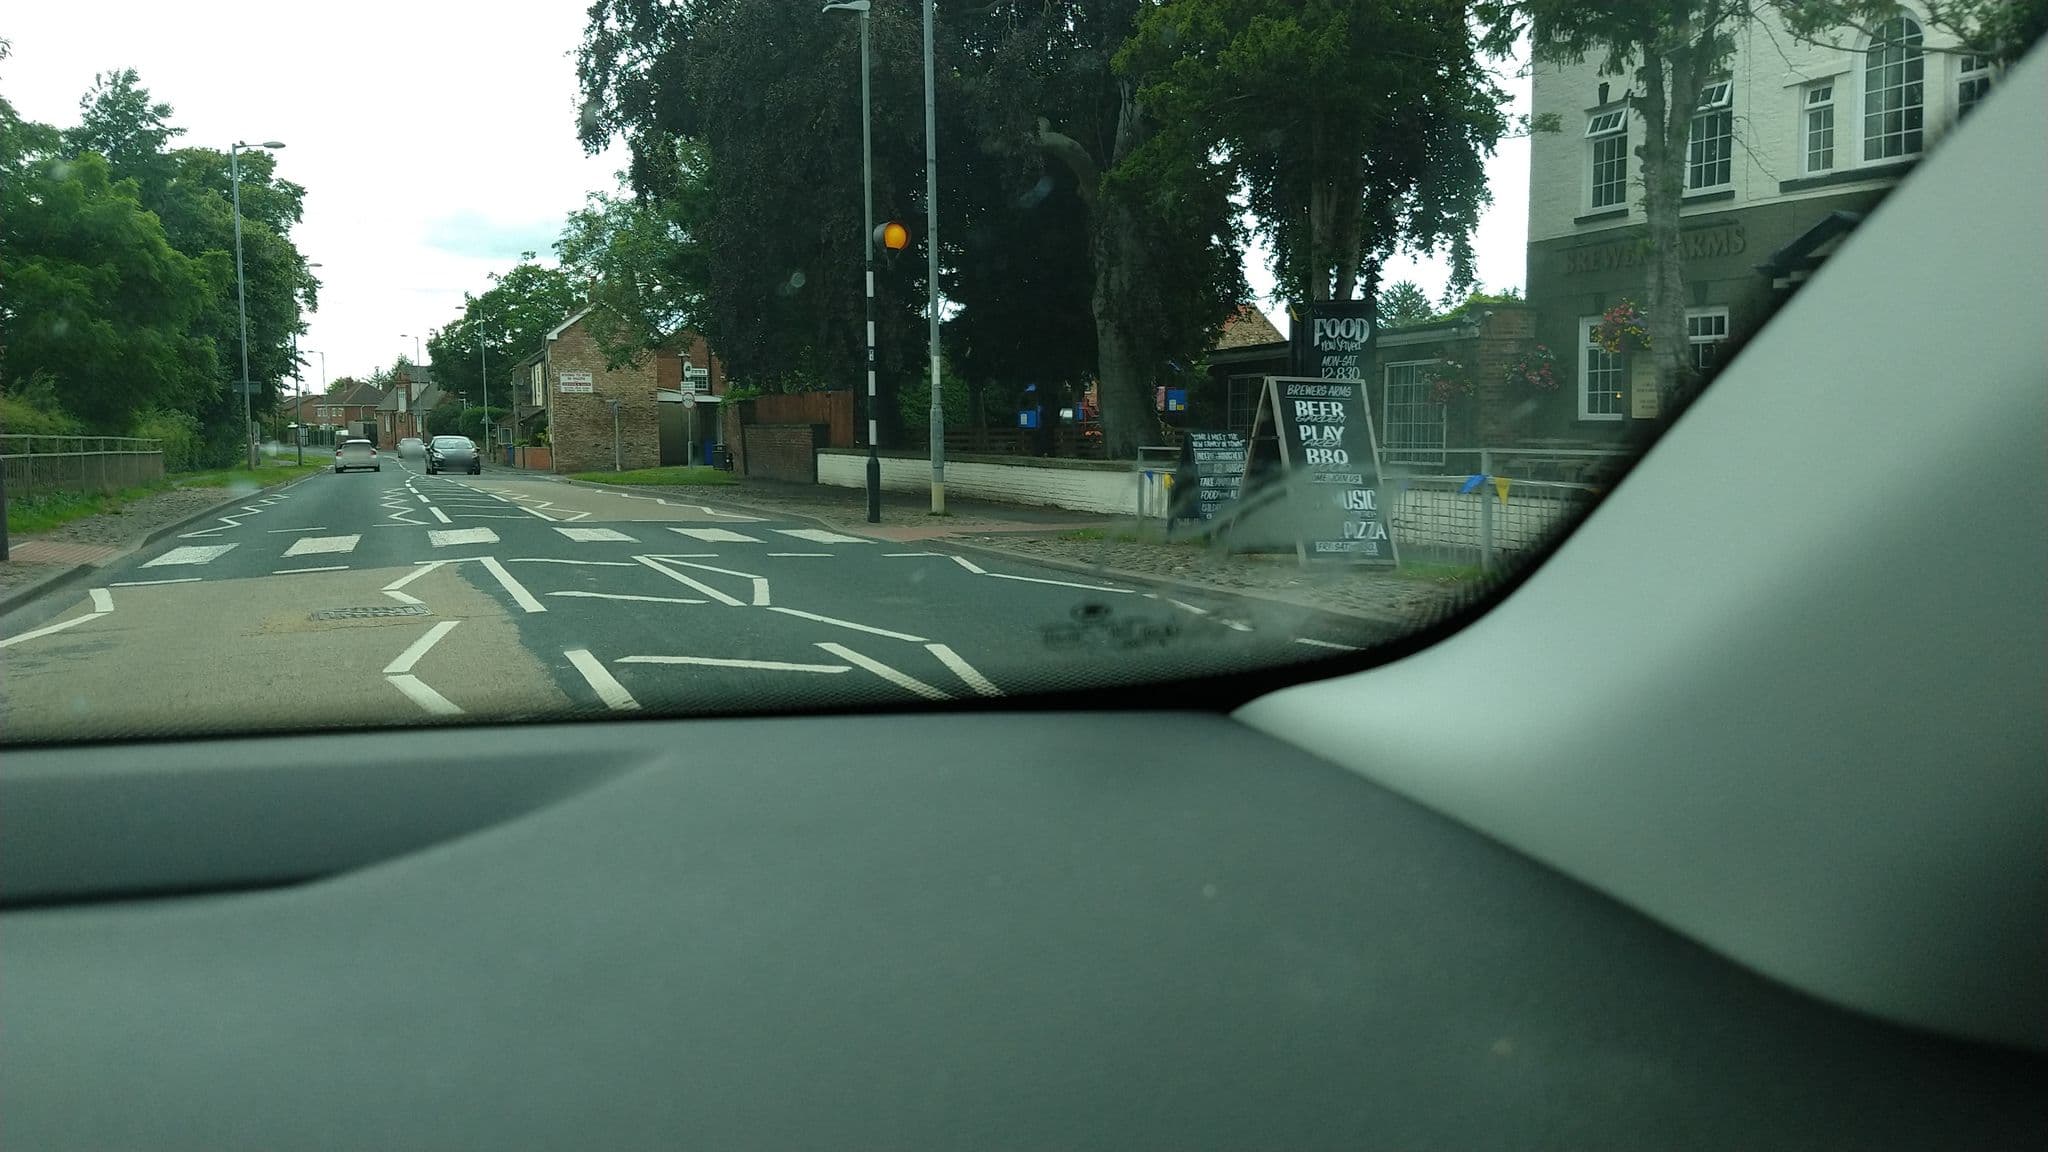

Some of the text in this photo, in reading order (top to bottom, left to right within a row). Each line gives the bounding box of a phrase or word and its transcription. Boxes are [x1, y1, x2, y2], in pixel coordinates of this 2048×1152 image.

[1313, 318, 1370, 347] FOOD
[1287, 384, 1352, 397] BREWERS ARMS
[1295, 400, 1345, 417] BEER
[1299, 425, 1345, 441] PLAY
[1306, 448, 1348, 465] BBQ
